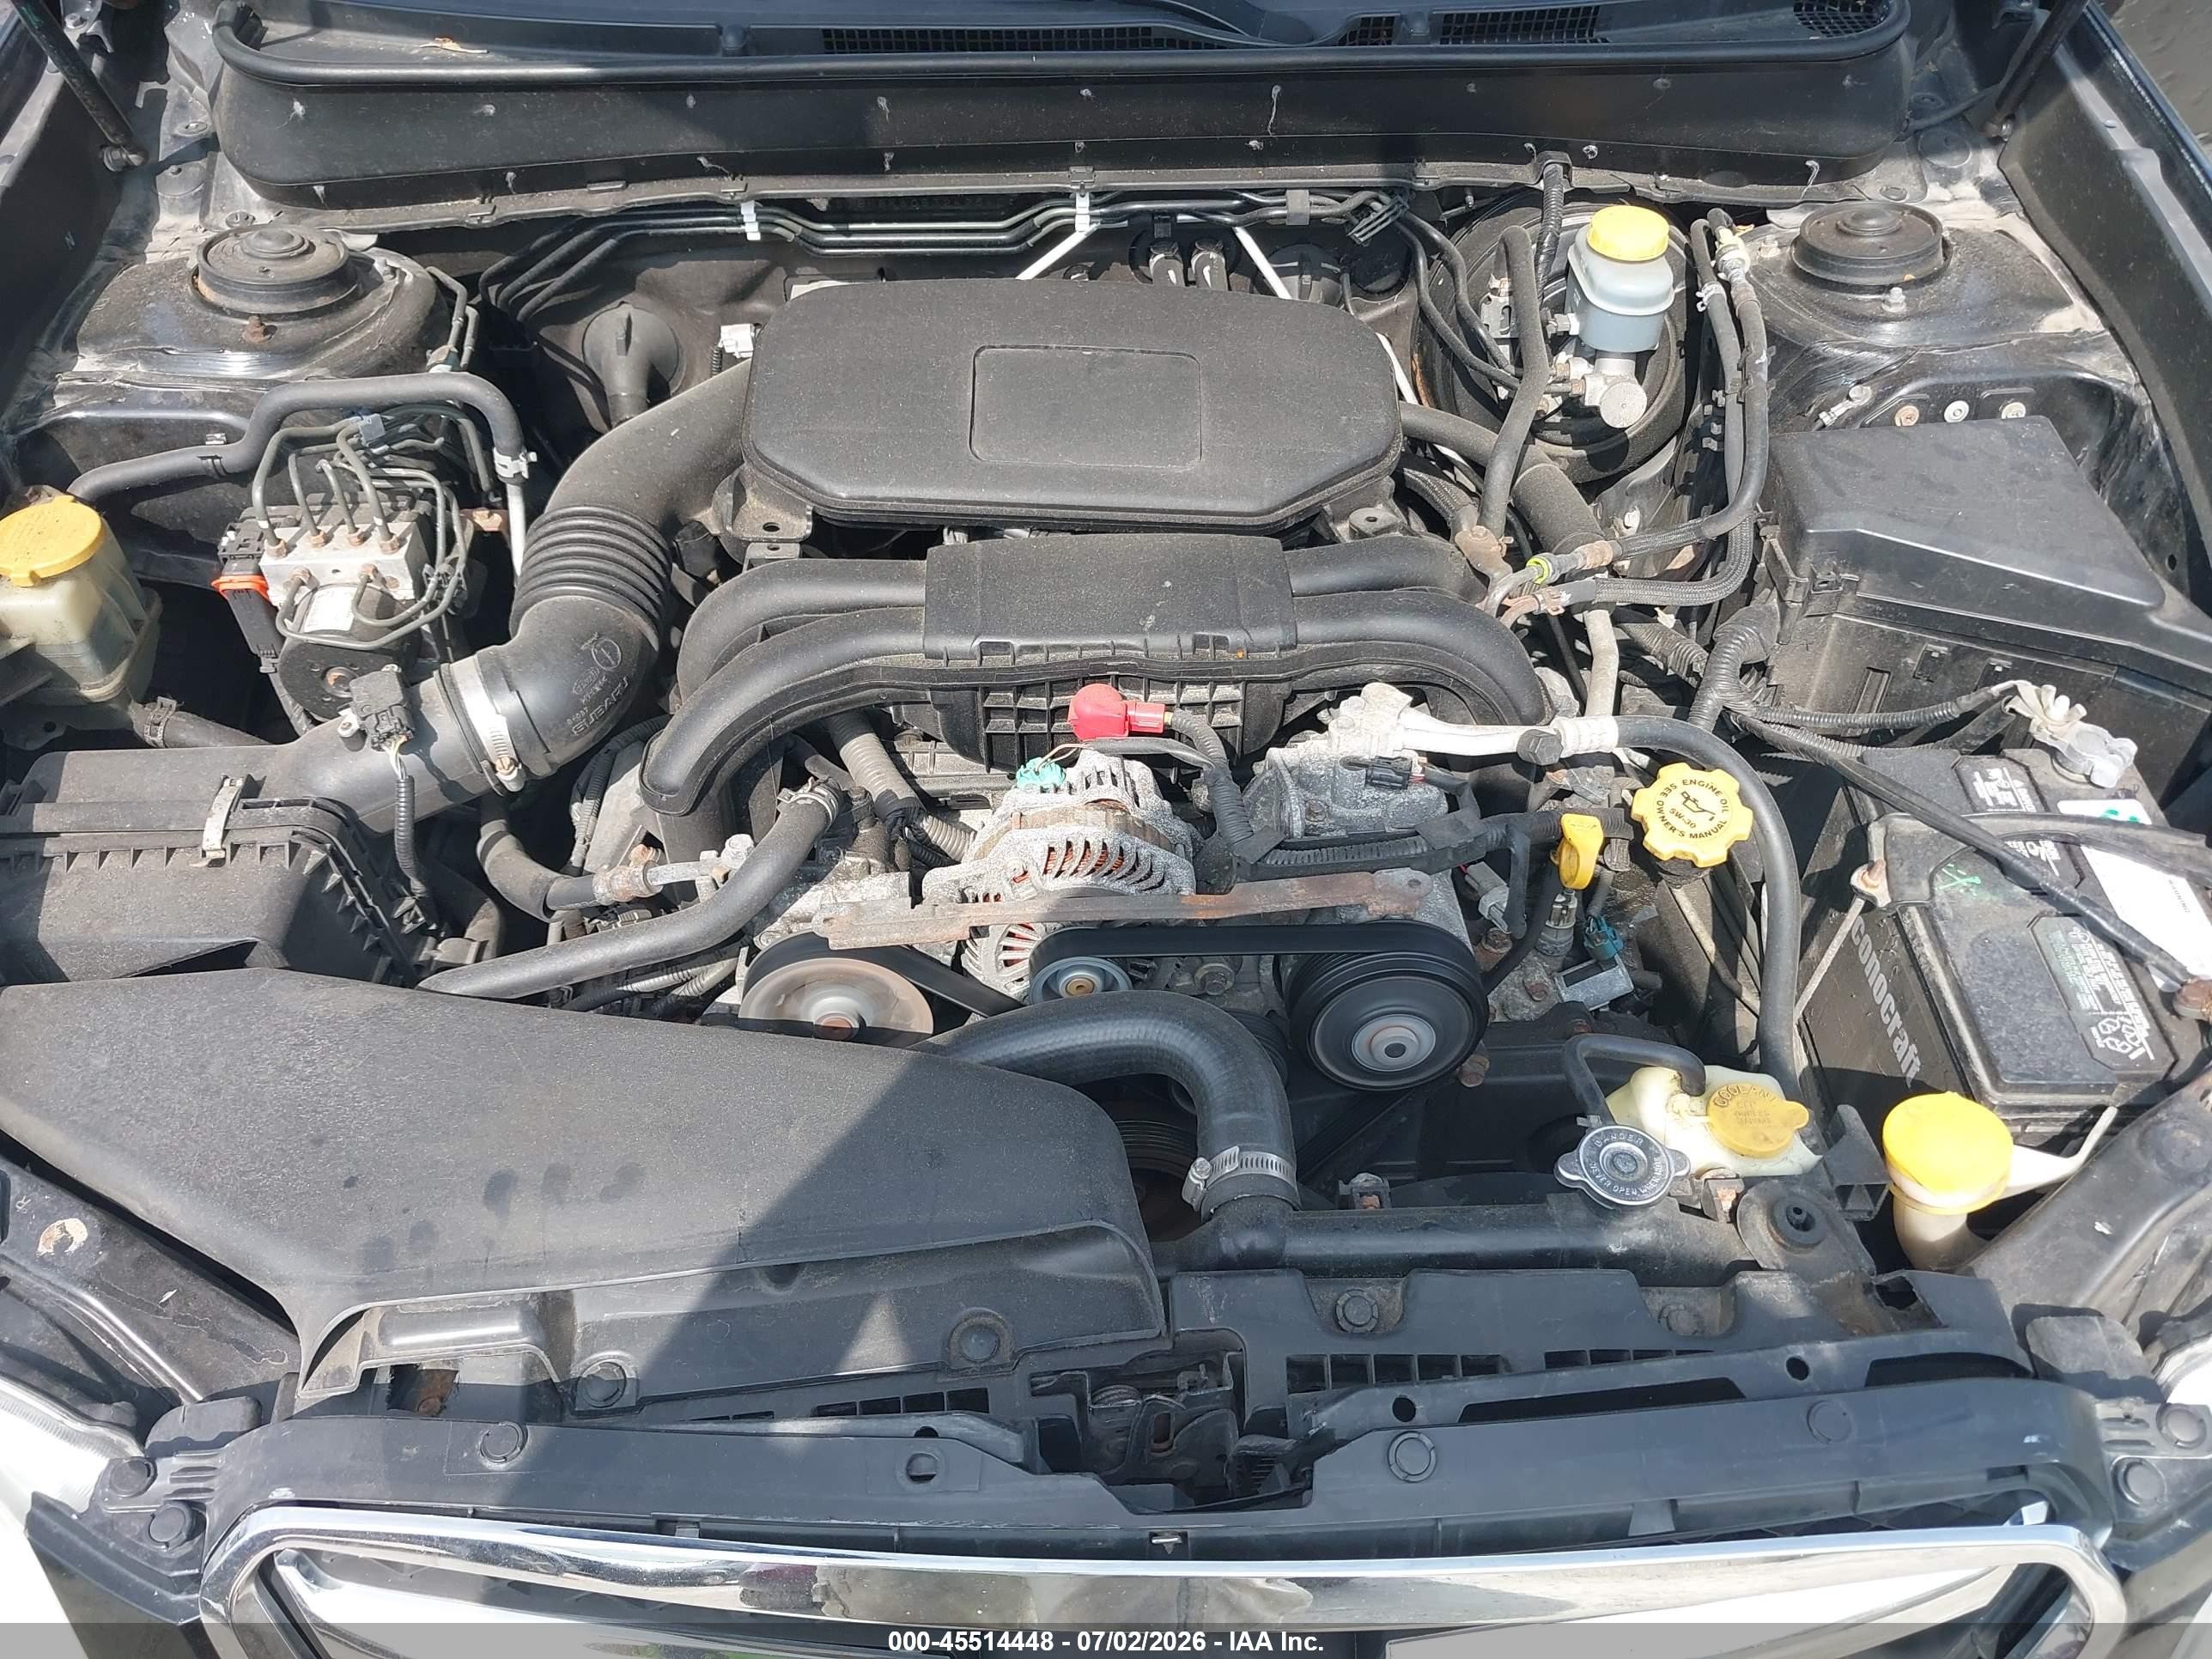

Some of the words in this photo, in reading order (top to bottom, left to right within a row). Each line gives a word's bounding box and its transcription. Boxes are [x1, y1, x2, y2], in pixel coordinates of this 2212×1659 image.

[571, 675, 629, 736] SUBARU
[1660, 782, 1679, 798] SEE
[1681, 779, 1723, 797] ENGINE
[1720, 798, 1729, 814] OIL
[1656, 799, 1686, 838] OWNER'S
[1669, 807, 1697, 830] 5W-30
[1689, 819, 1728, 840] MANUAL
[1851, 915, 1921, 1090] conocraft
[1714, 1084, 1778, 1108] COOLANT
[1589, 1162, 1612, 1188] NEVER
[1613, 1185, 1638, 1196] OPEN
